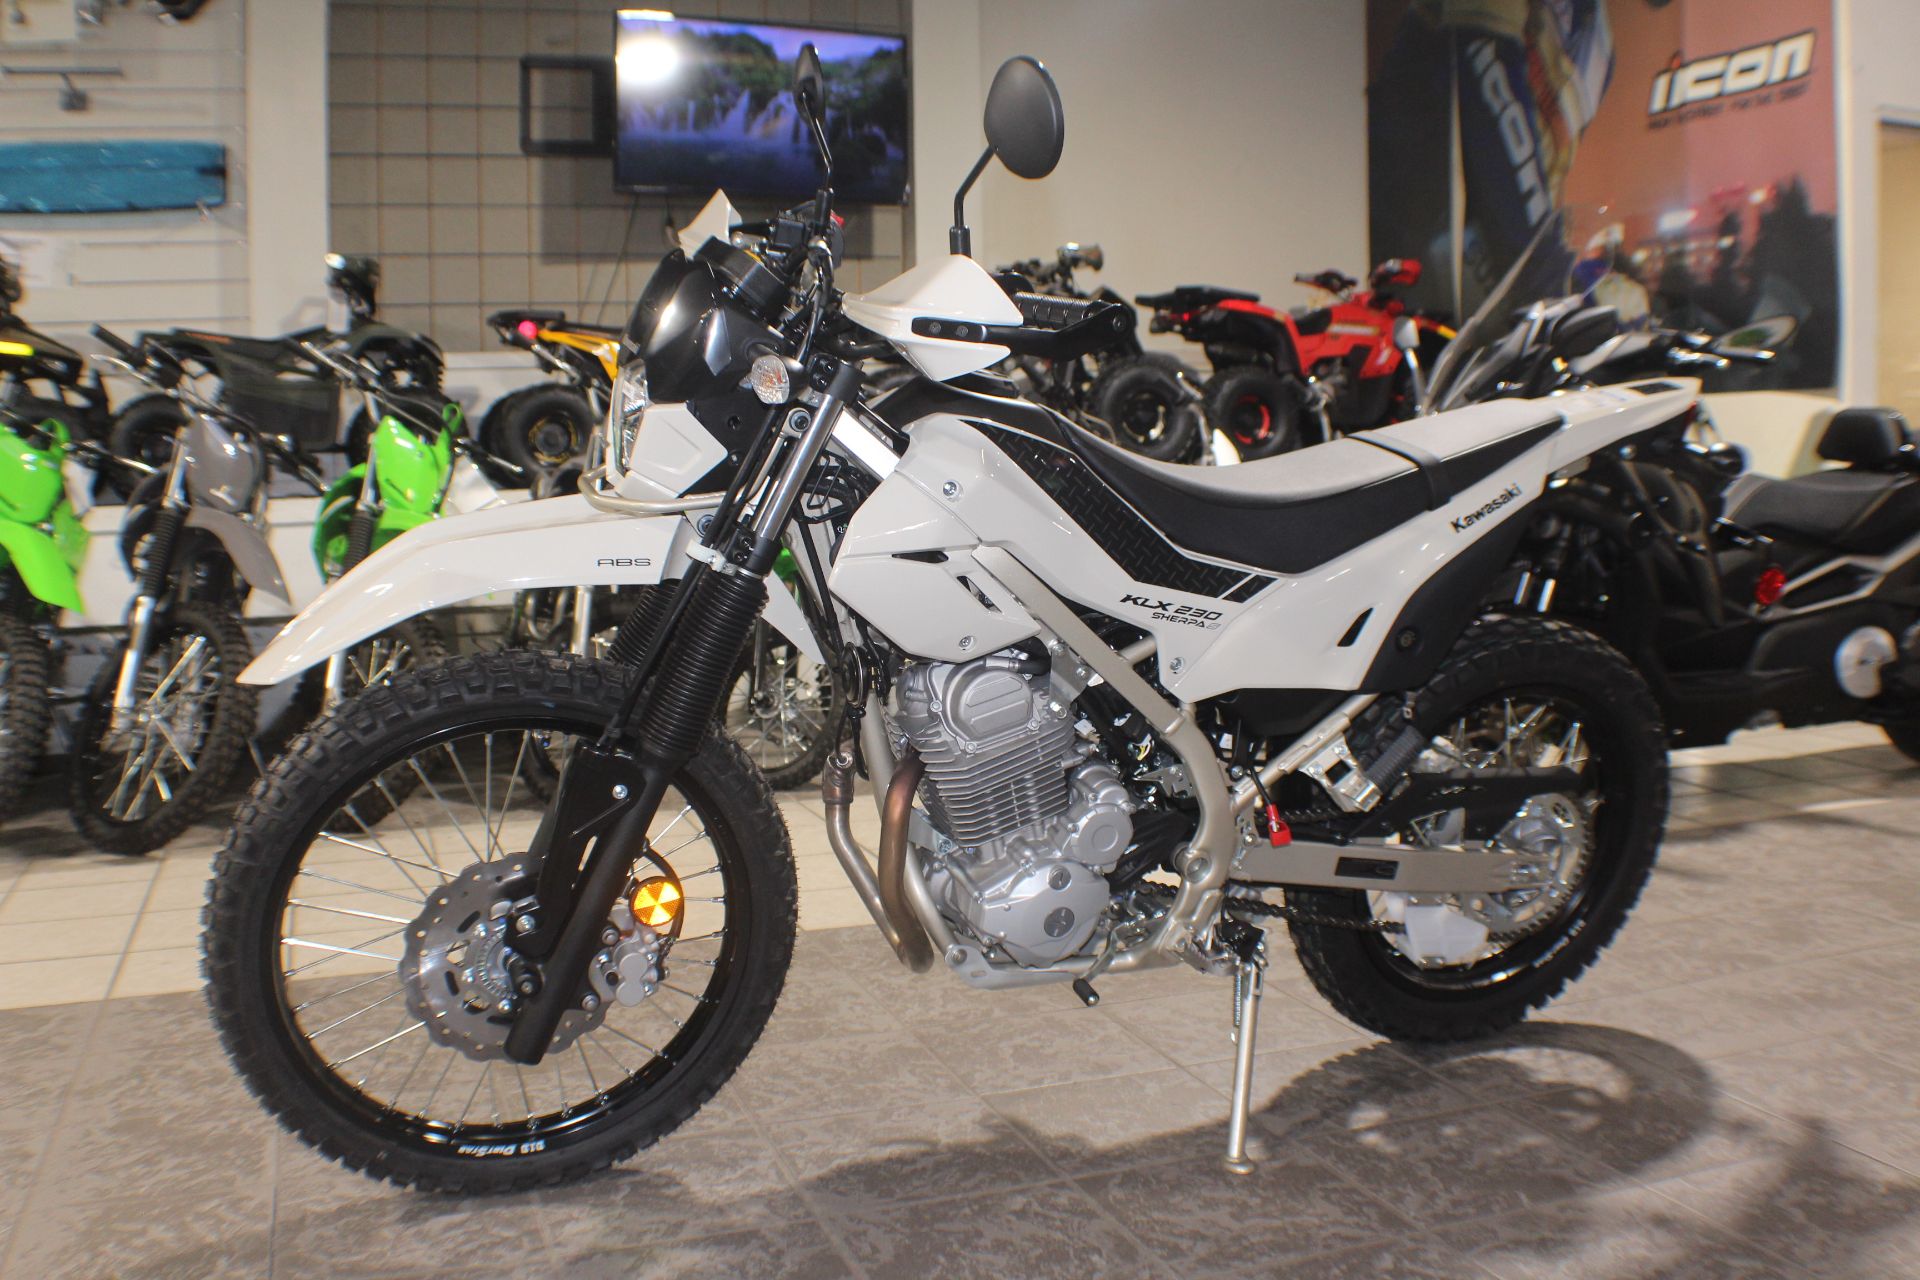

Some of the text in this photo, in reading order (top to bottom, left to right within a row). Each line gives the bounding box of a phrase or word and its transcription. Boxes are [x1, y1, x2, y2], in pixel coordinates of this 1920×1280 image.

[1450, 482, 1522, 533] Kawasaki
[597, 558, 651, 567] ABS
[1119, 594, 1223, 621] KLX 230
[1151, 612, 1205, 628] SHERPA
